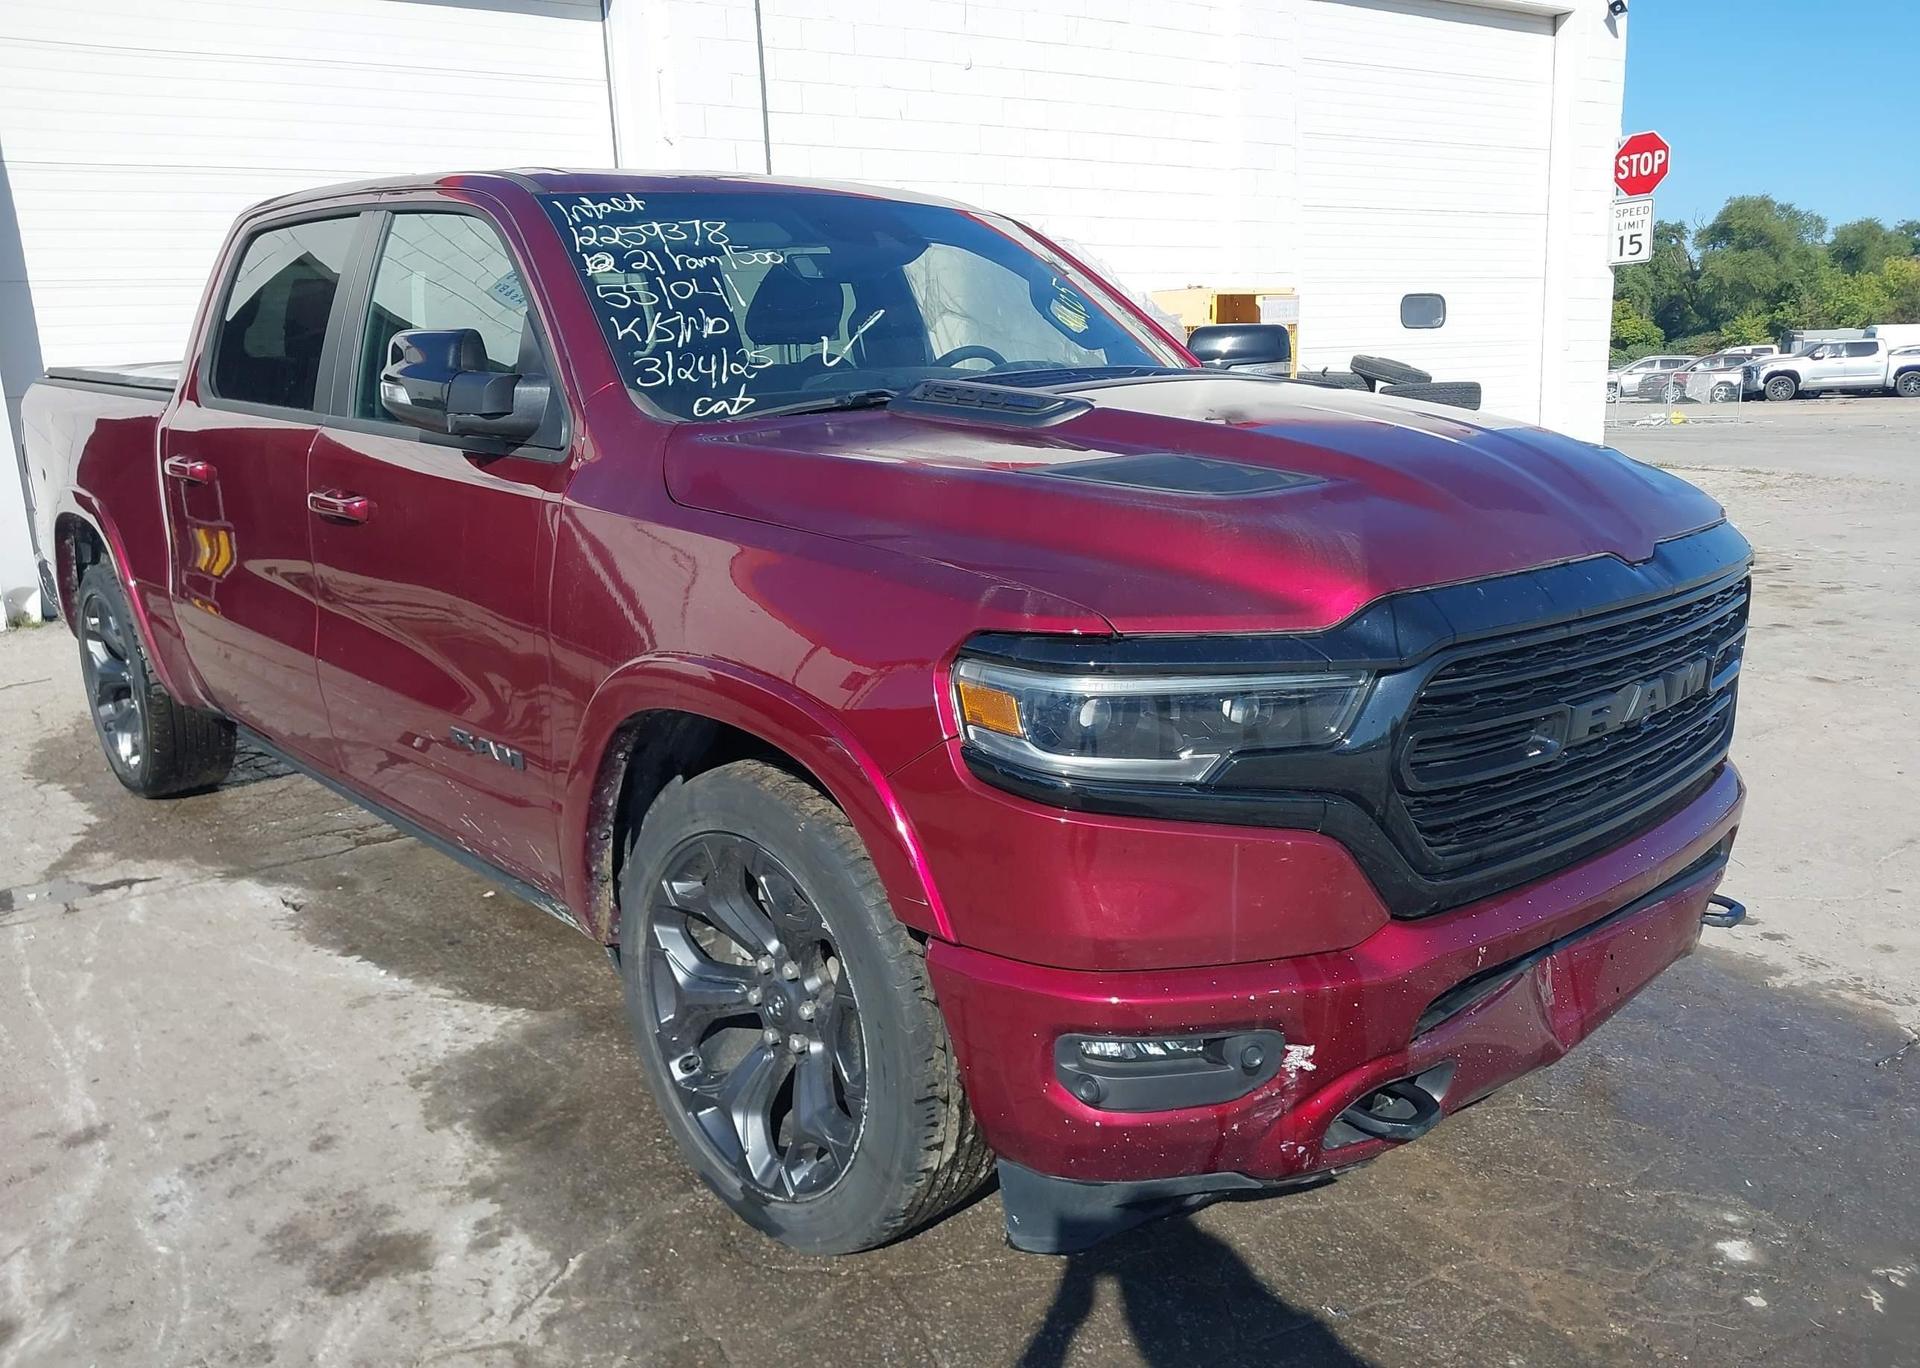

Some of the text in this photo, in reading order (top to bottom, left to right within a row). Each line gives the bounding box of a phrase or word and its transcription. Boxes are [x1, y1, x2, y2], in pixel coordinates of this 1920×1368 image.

[1617, 149, 1666, 180] STOP
[1615, 205, 1650, 218] SPEED
[1617, 219, 1646, 232] LIMIT
[1618, 233, 1643, 257] 15
[633, 347, 775, 389] 3/24/25
[1570, 656, 1708, 742] RAM
[449, 726, 526, 772] RAM
